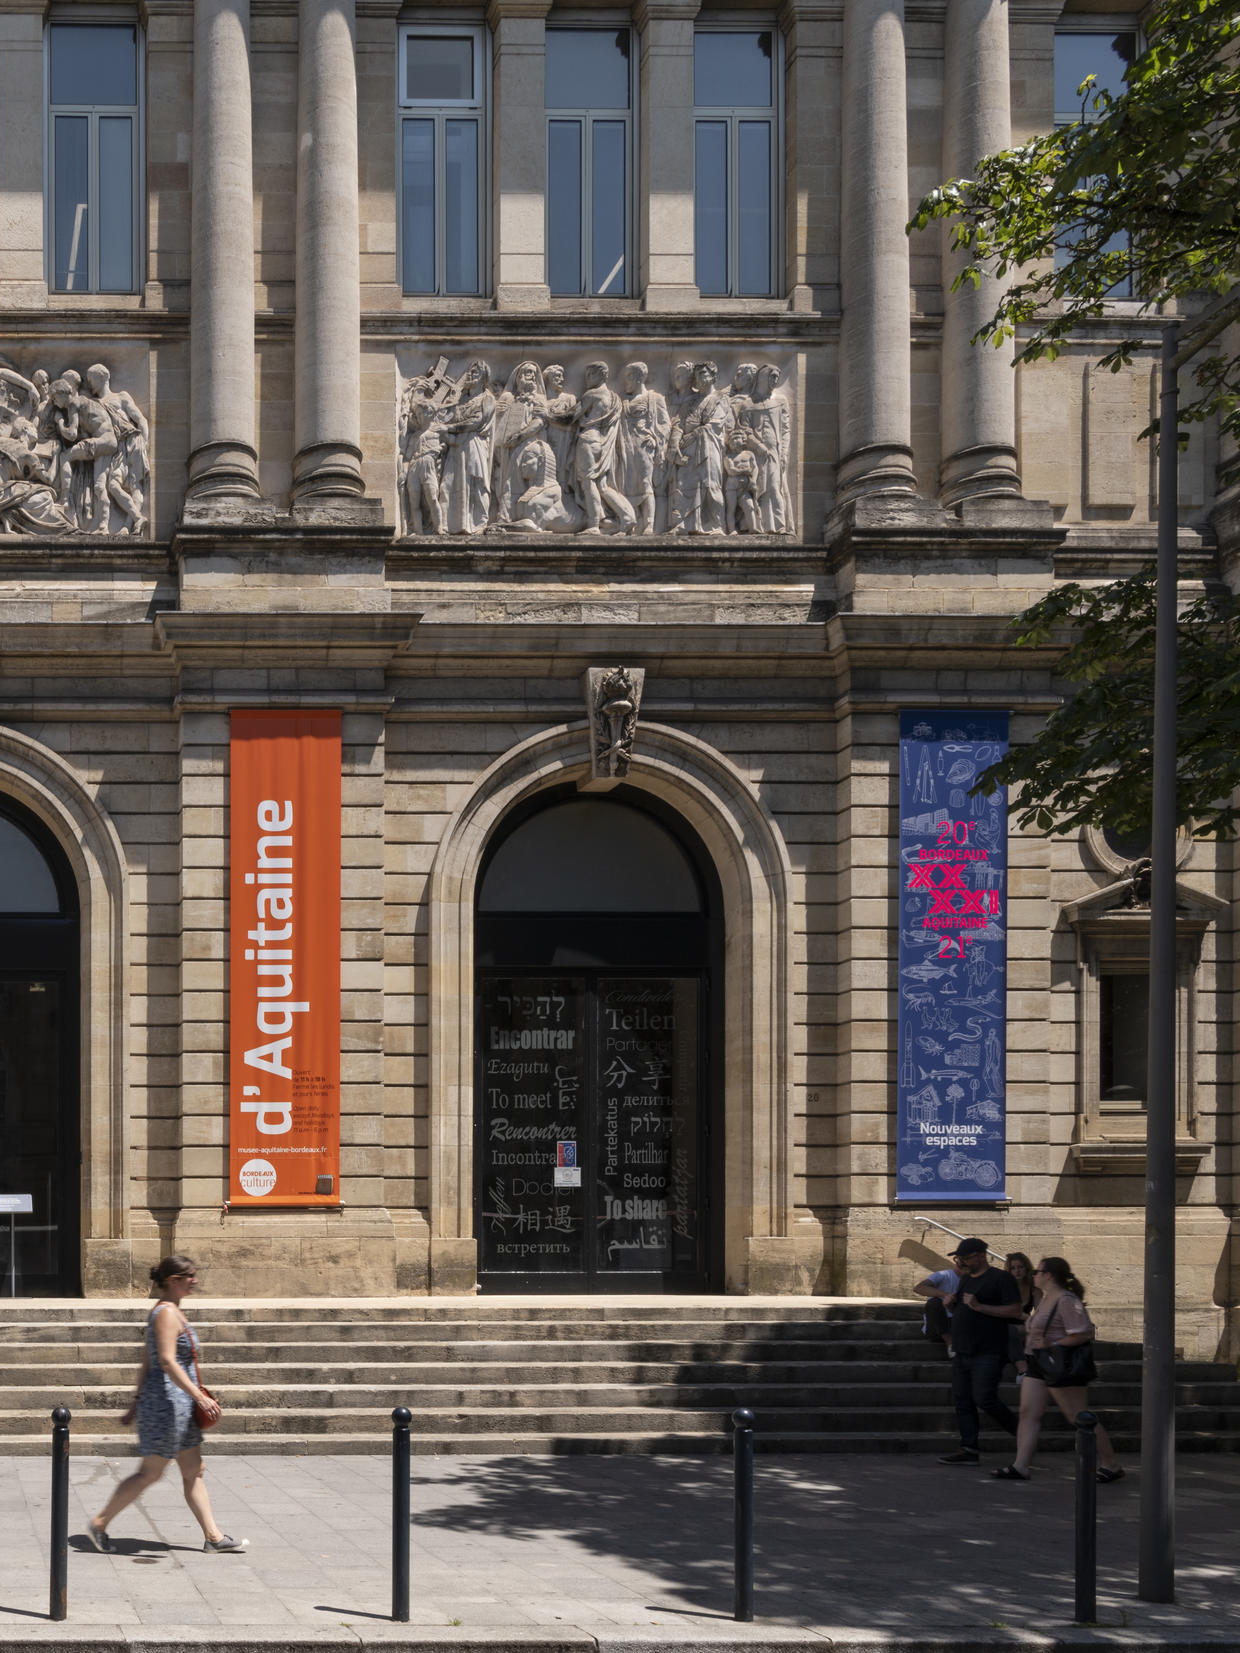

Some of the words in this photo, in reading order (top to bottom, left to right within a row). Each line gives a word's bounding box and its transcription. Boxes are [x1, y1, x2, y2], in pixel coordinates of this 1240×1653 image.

[919, 849, 988, 861] BORDEAUX
[907, 864, 968, 889] XX
[922, 917, 989, 930] AQUITAINE
[241, 800, 310, 1135] d'Aquitaine
[605, 1008, 676, 1030] Teilen
[490, 1026, 576, 1050] Encontrar
[487, 1059, 549, 1082] Ezagutu
[603, 1055, 672, 1090] 分享
[488, 1088, 509, 1109] To
[514, 1090, 552, 1109] meet
[622, 1095, 690, 1109] делиться
[489, 1117, 577, 1142] Rencontrer
[920, 1122, 983, 1135] Nouveaux
[238, 1146, 327, 1154] musee-aquitaine-bordeaux.fr
[624, 1142, 668, 1164] Partilhar
[926, 1136, 977, 1149] espaces
[491, 1150, 557, 1165] Incontra
[241, 1178, 275, 1188] culture
[624, 1173, 666, 1188] Sedoo
[604, 1195, 622, 1220] To
[625, 1195, 667, 1220] share
[512, 1204, 576, 1234] 相遇
[496, 1243, 570, 1257] встретить
